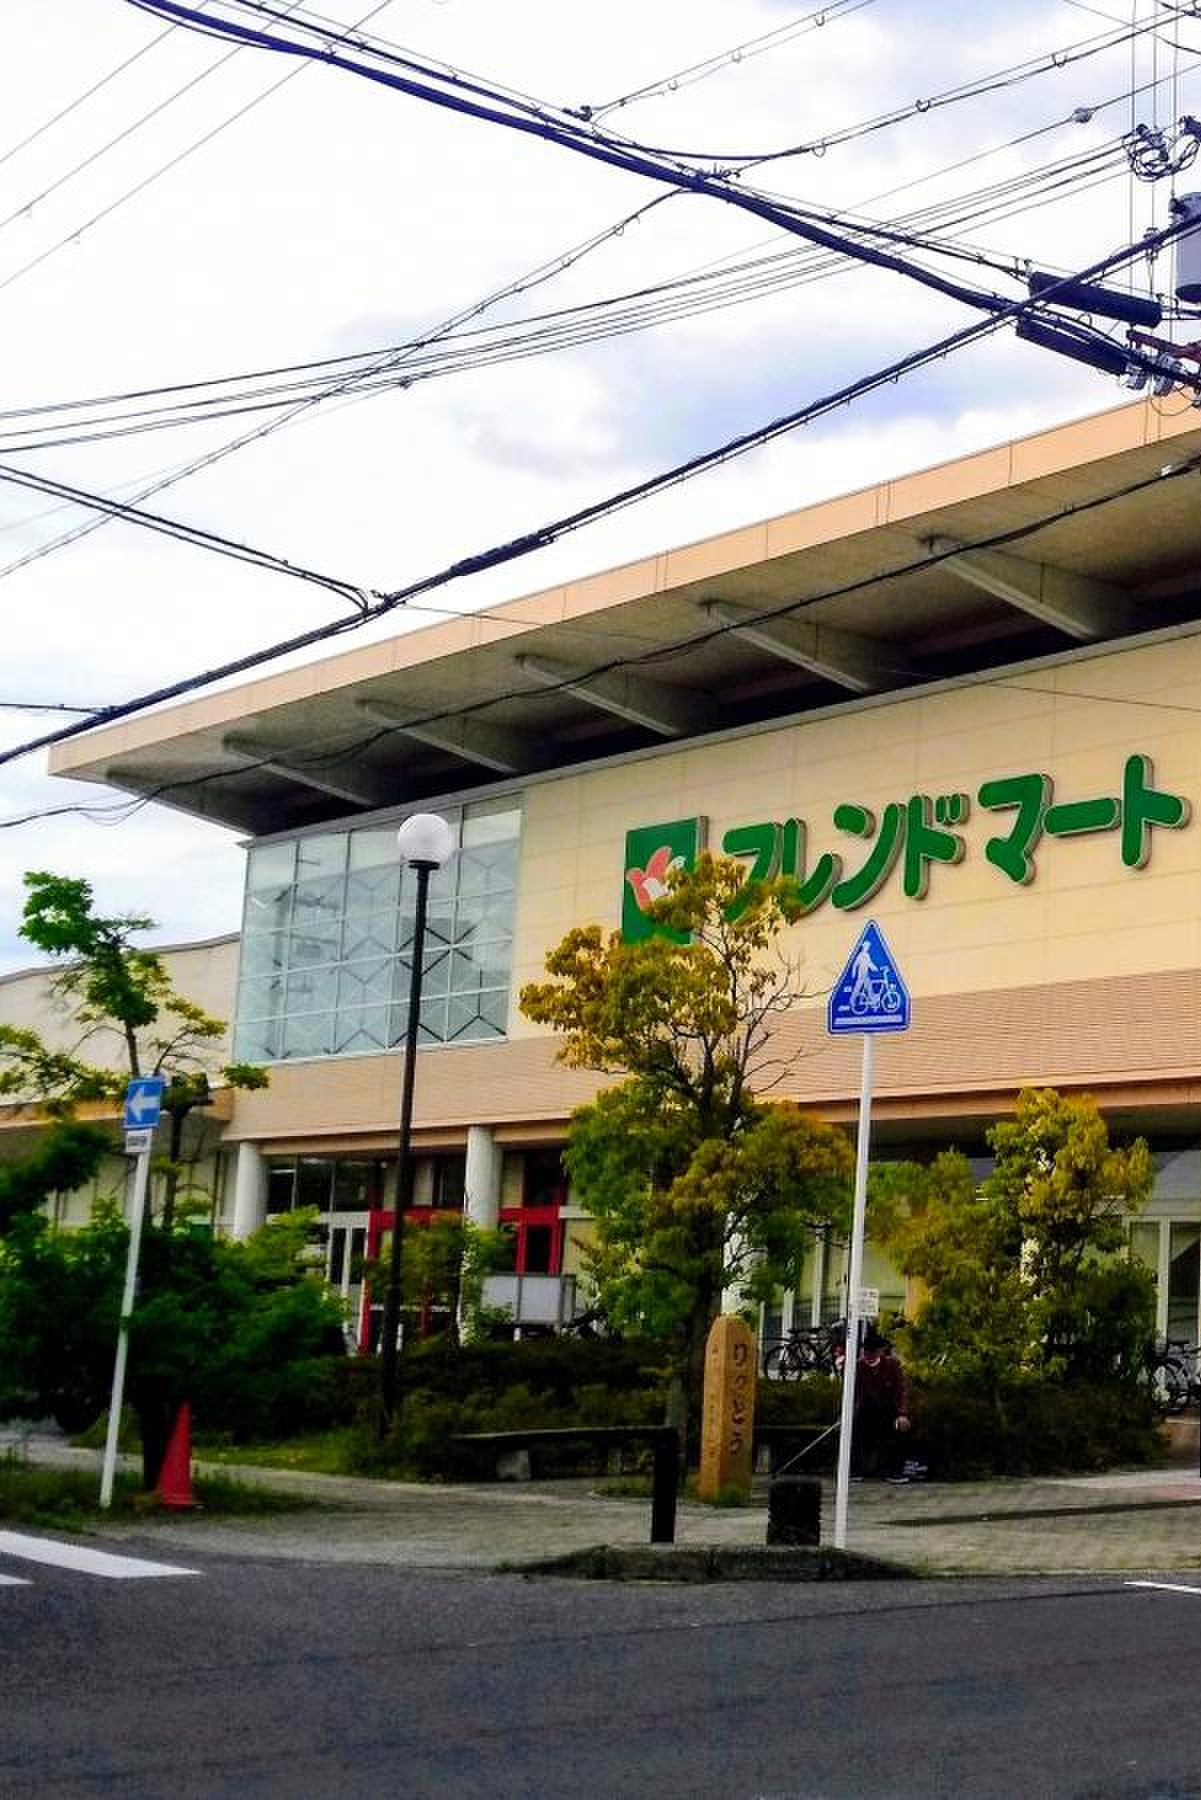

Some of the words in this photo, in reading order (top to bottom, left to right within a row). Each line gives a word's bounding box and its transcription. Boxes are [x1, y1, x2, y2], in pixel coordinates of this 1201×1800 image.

[722, 753, 1191, 922] フレンドマート
